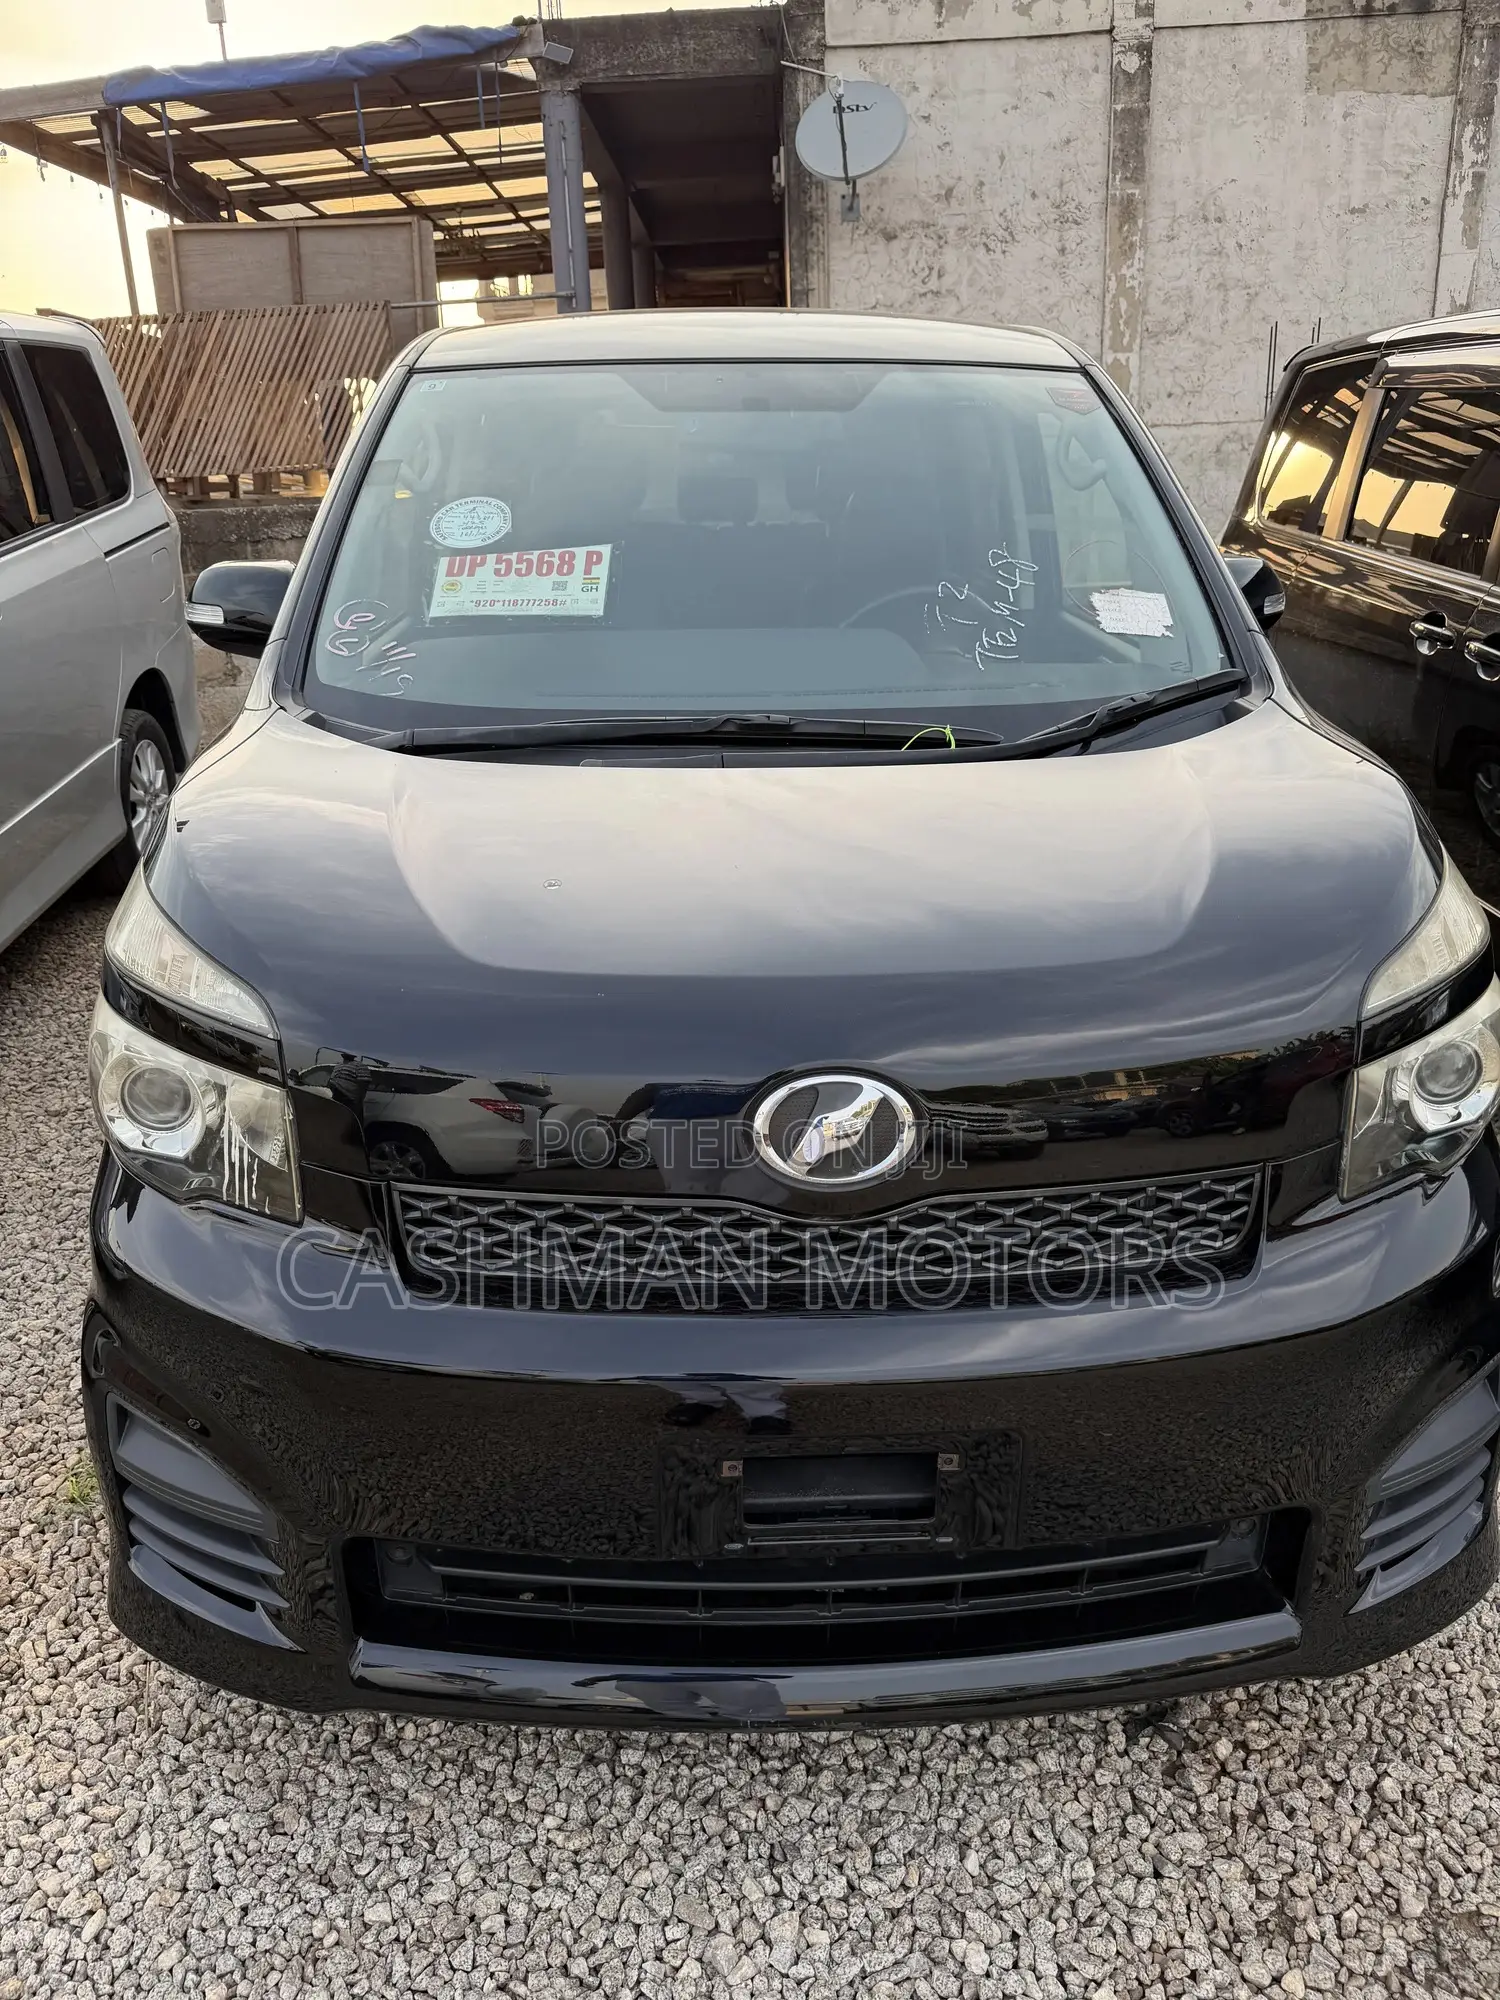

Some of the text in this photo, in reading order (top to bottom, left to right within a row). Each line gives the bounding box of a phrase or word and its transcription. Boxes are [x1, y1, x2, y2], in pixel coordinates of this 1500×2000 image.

[455, 499, 493, 508] TERMINAL
[444, 550, 604, 578] DP 5568 P
[581, 585, 599, 593] GH
